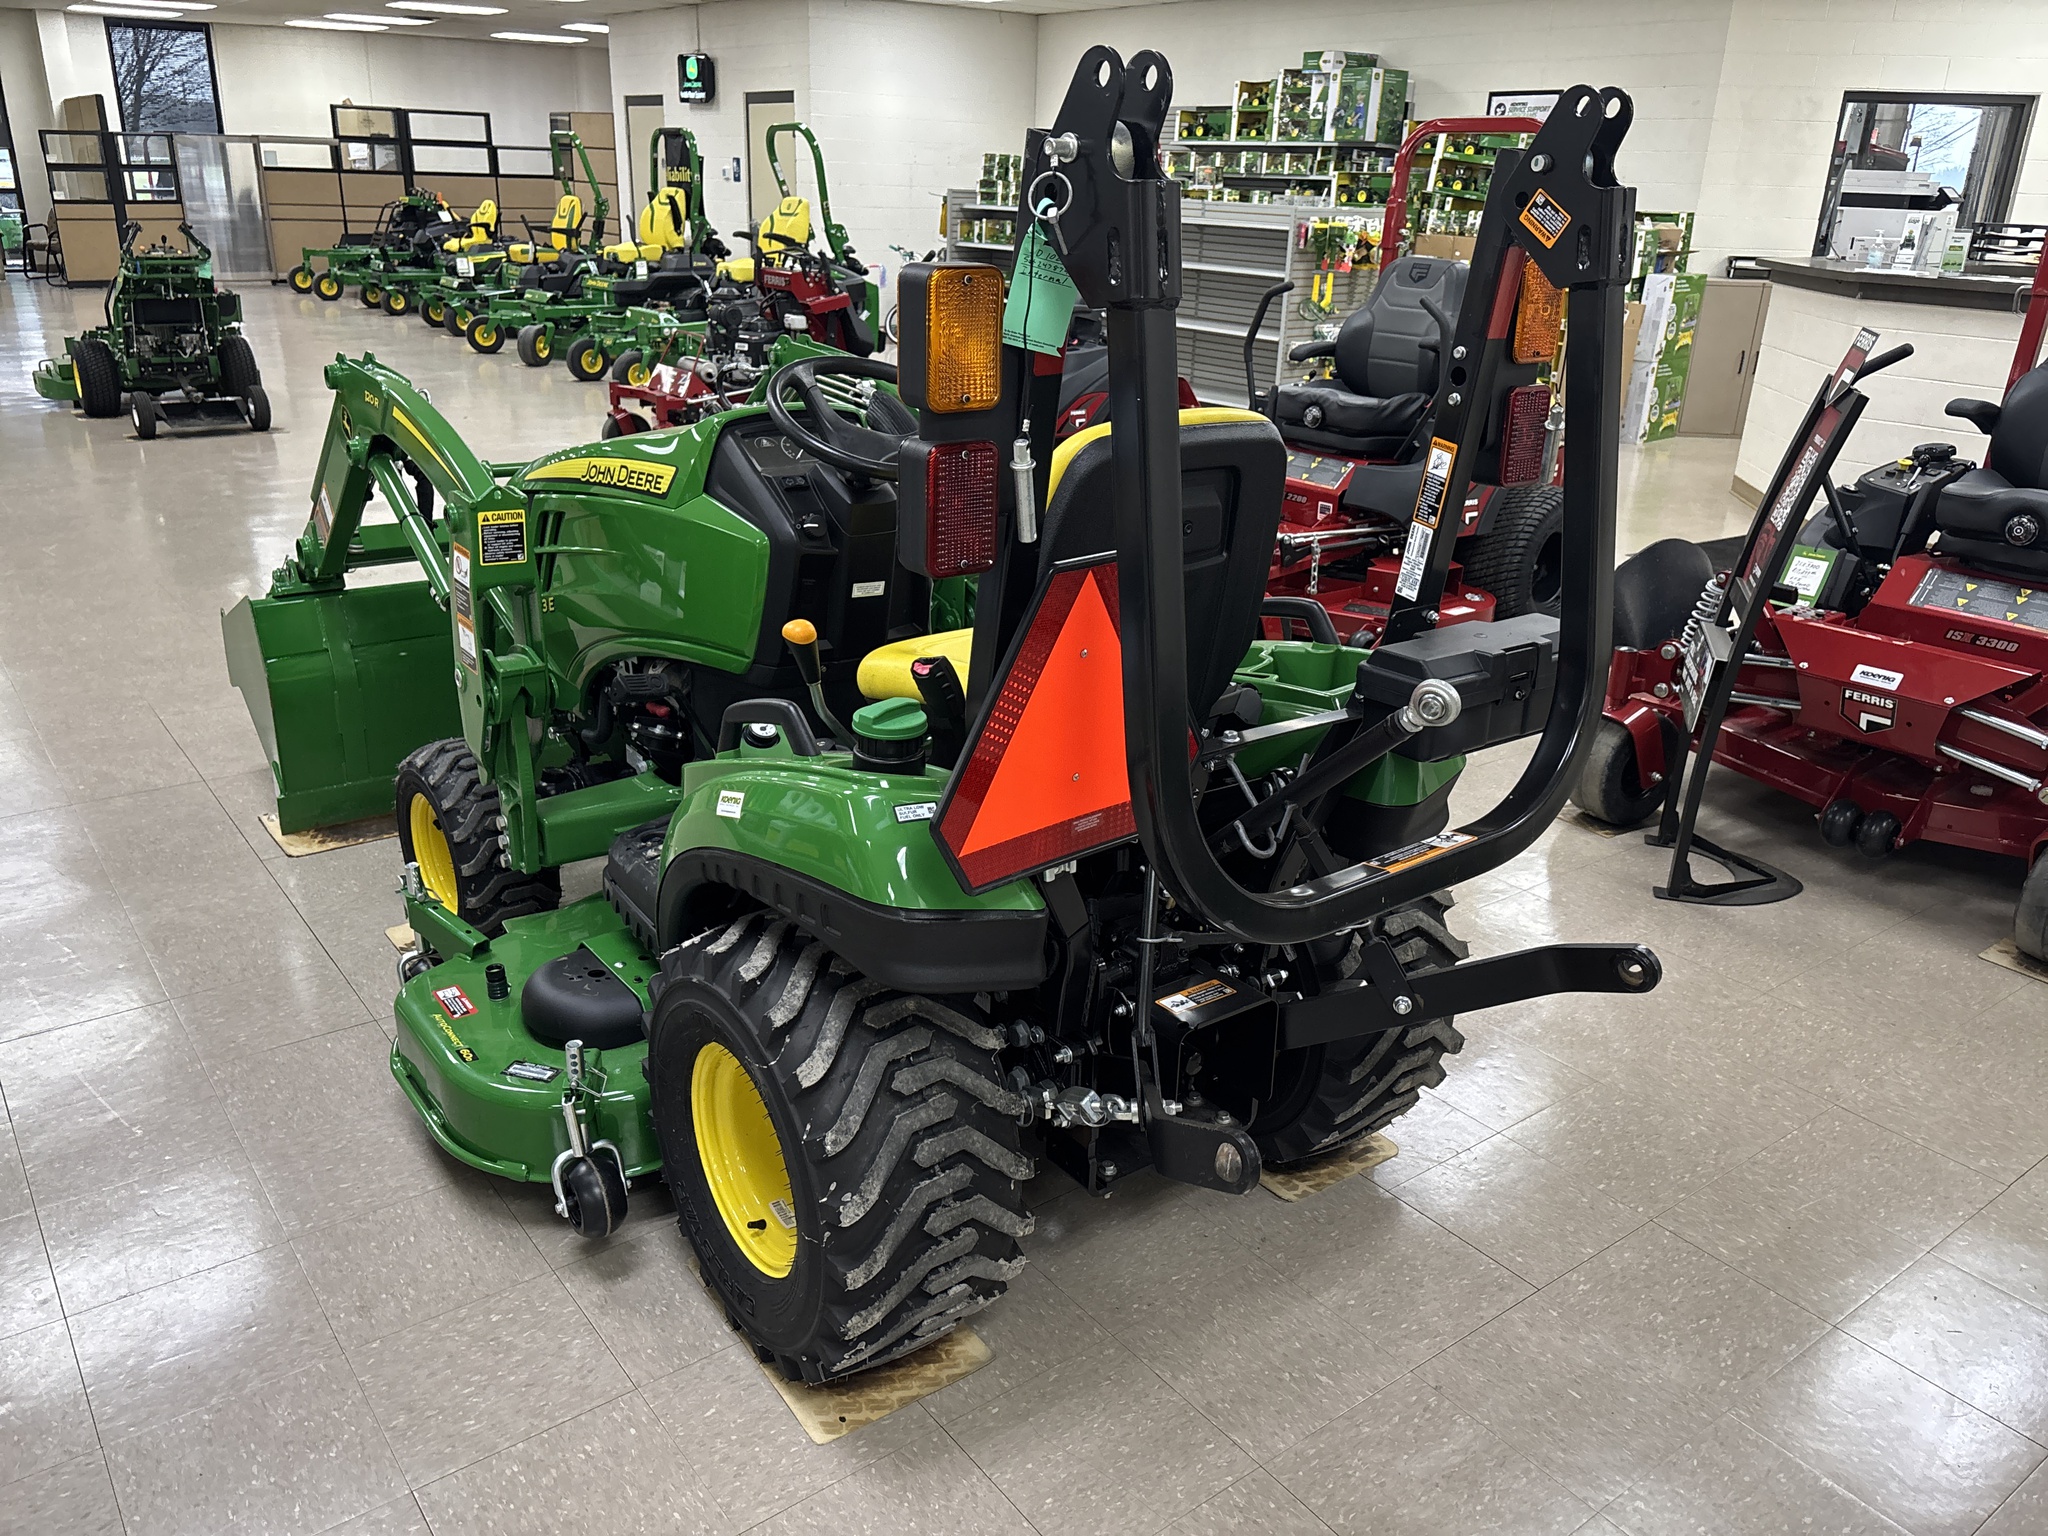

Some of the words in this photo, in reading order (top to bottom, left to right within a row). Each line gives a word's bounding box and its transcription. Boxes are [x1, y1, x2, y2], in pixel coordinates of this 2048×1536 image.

[1524, 214, 1546, 238] WARNING
[764, 274, 786, 286] FERRIS
[582, 462, 616, 482] JOHN
[617, 465, 664, 490] DEERE
[492, 512, 522, 521] CAUTION
[1946, 630, 1974, 642] ISX
[1976, 634, 2019, 652] 3300
[1845, 690, 1894, 709] FERRIS
